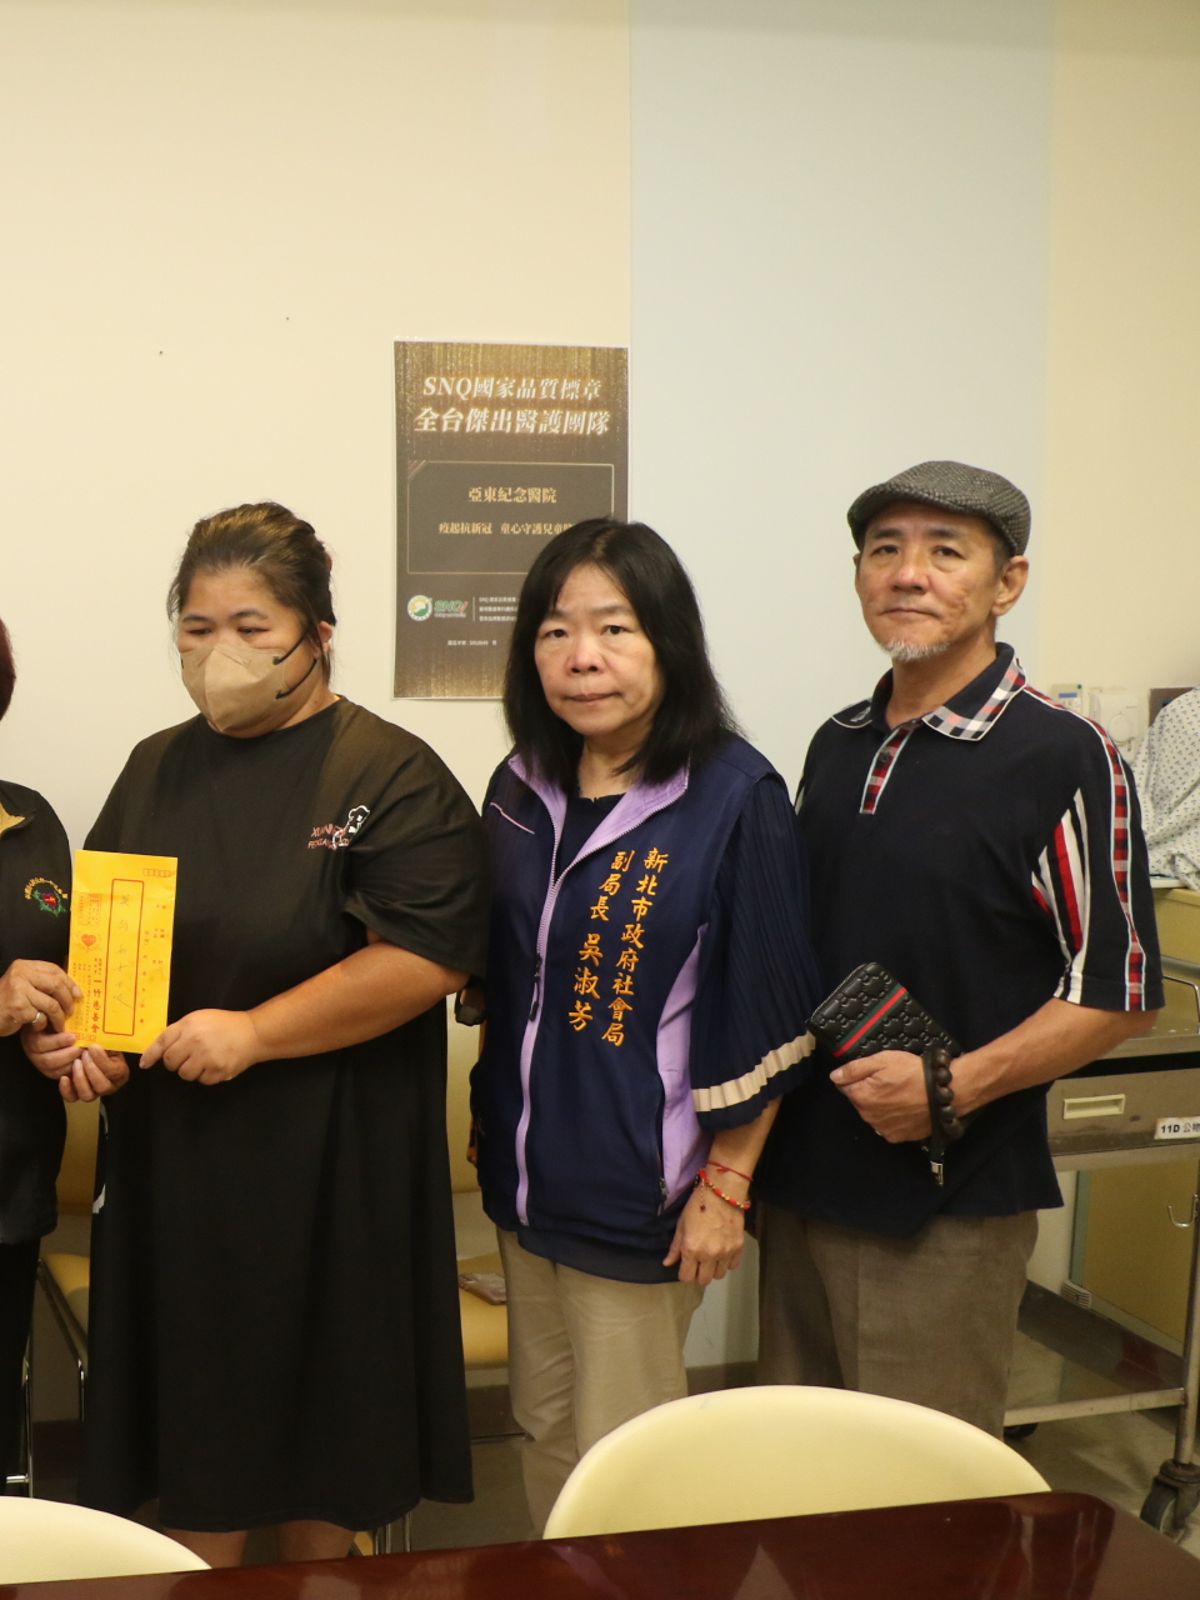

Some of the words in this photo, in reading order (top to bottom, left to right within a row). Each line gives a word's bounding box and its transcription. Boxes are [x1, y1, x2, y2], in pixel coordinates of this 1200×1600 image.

[423, 376, 602, 401] SNQ國家品質標章
[414, 406, 611, 436] 全台傑出醫護團隊
[468, 486, 557, 504] 亞東紀念醫院
[590, 849, 635, 922] 副局長
[602, 847, 669, 1047] 新北市政府社會局
[568, 932, 604, 1031] 吳淑芳
[1161, 1124, 1180, 1133] 11D
